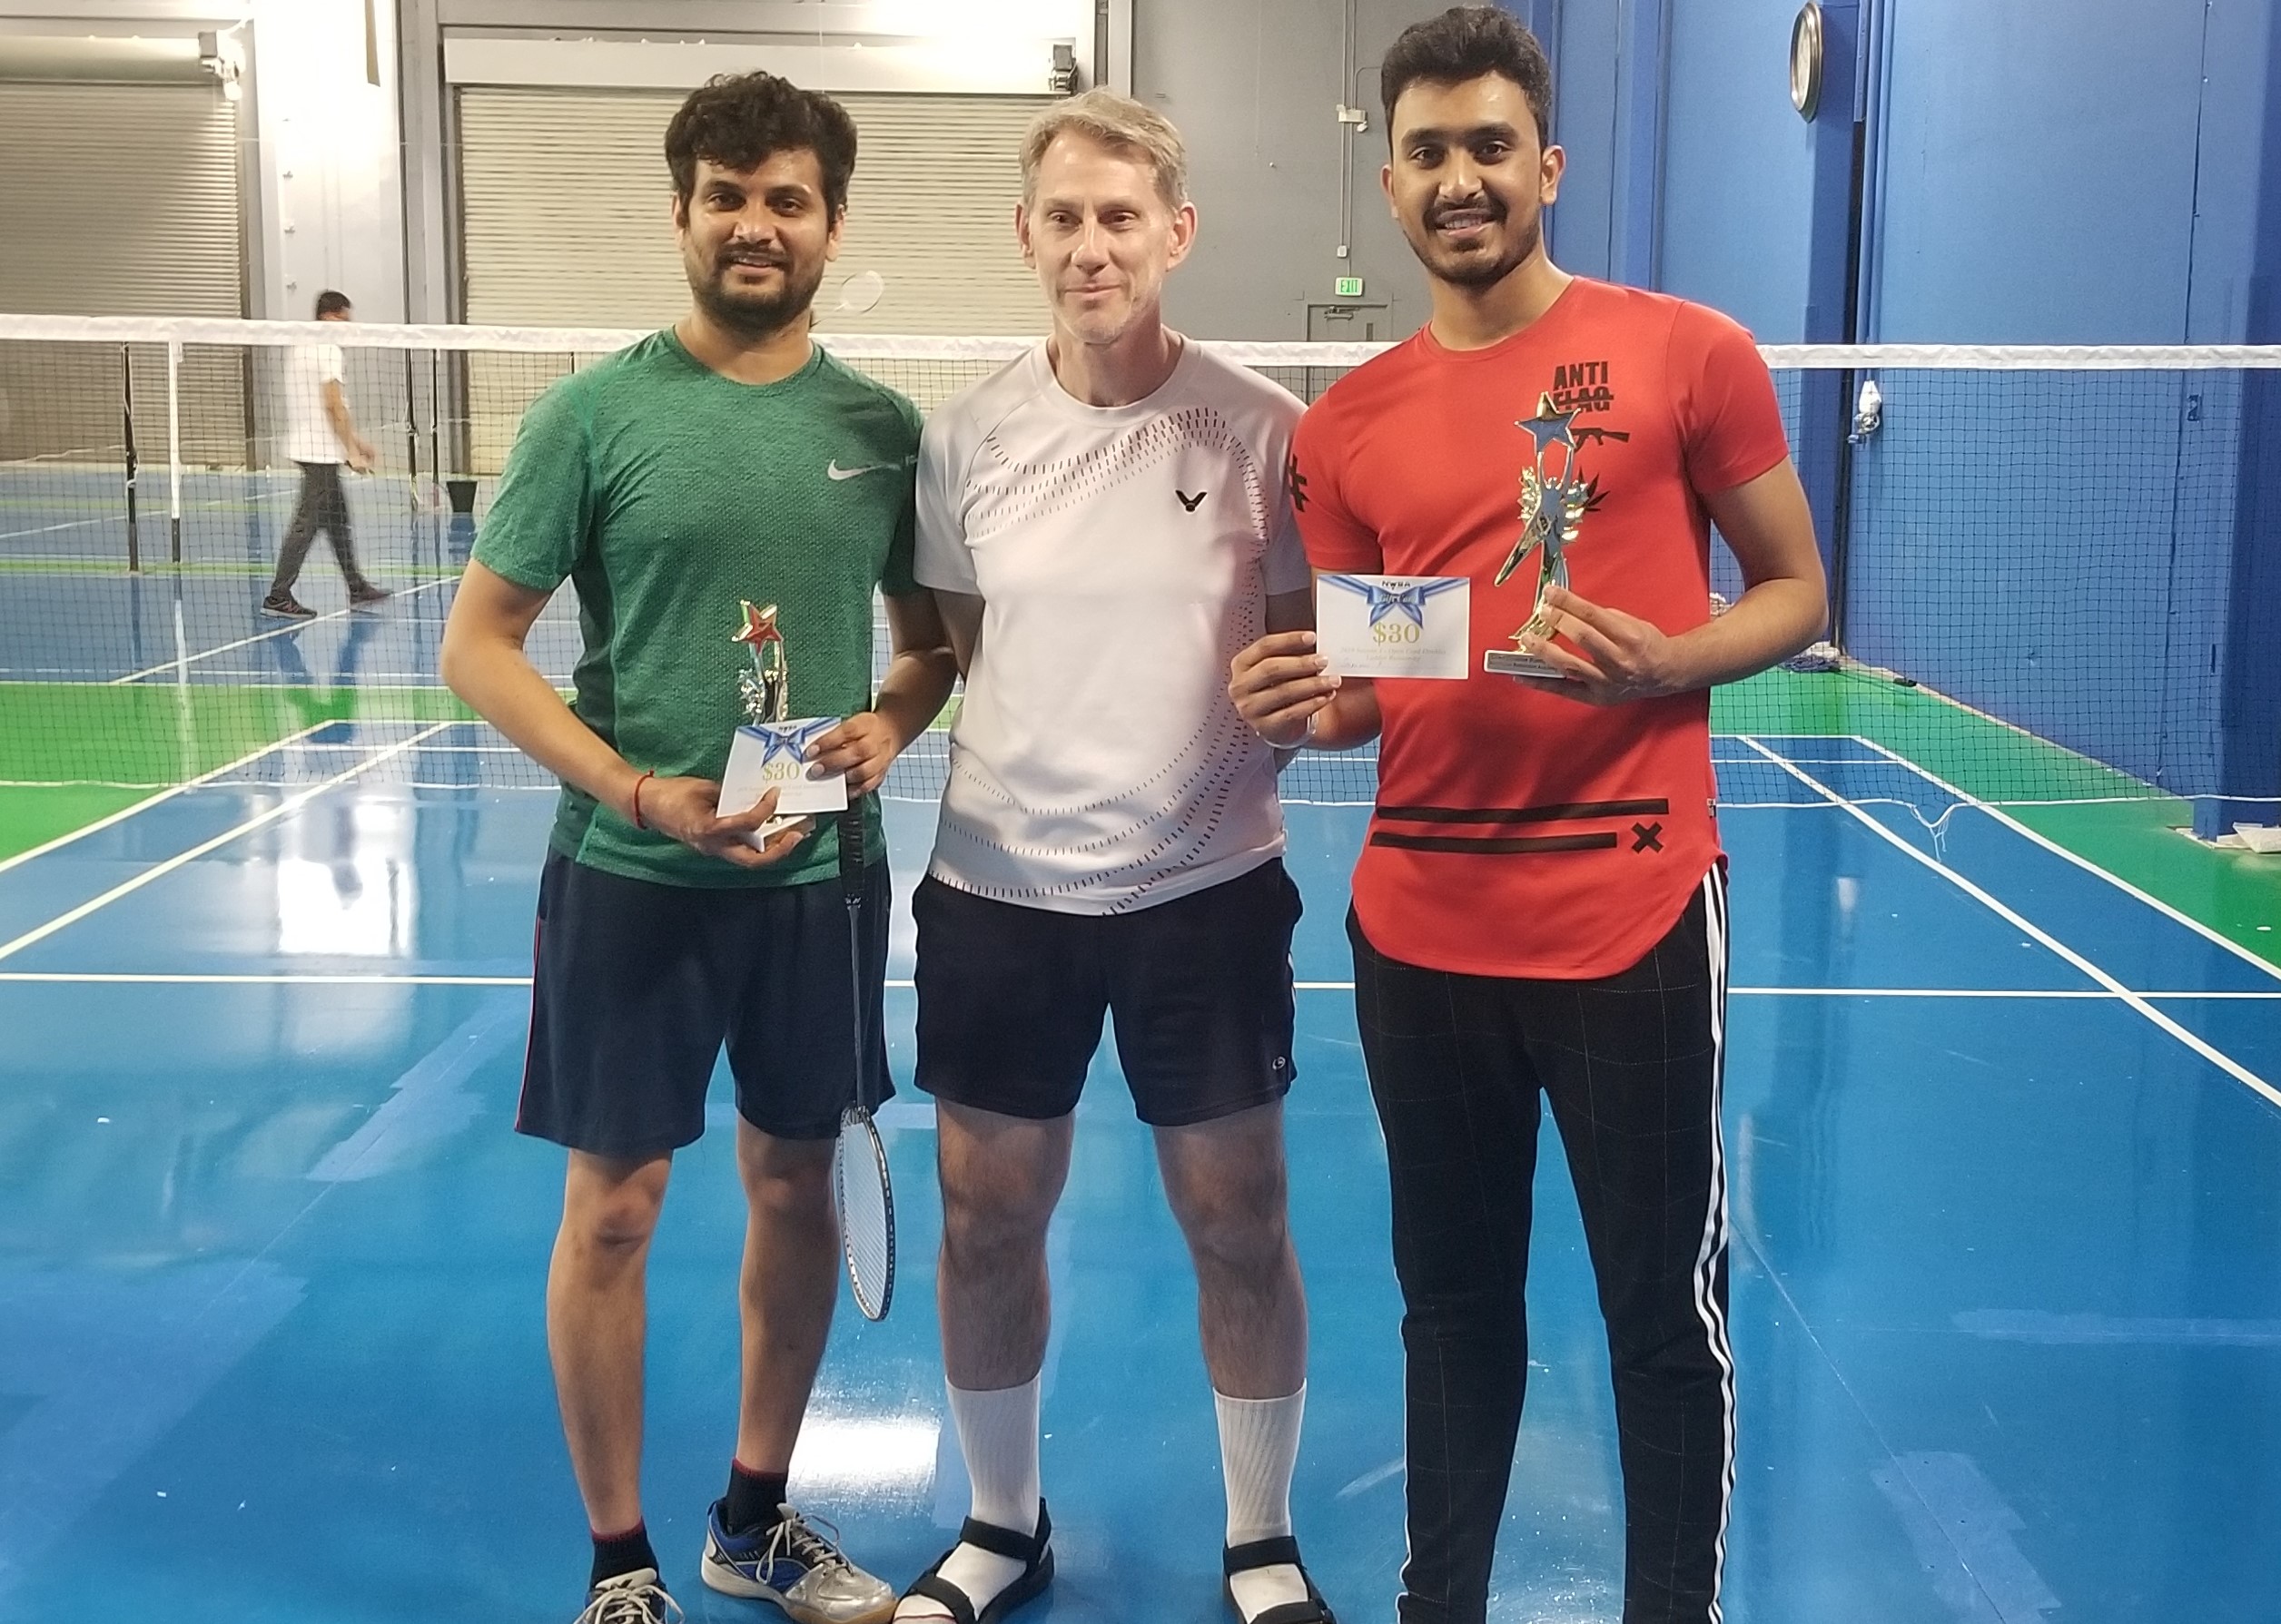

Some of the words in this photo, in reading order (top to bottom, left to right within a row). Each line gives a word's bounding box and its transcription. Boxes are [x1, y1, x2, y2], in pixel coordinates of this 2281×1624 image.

[1340, 279, 1358, 293] EXIT
[1553, 360, 1608, 391] ANTI
[1372, 622, 1420, 646] $30
[762, 762, 801, 783] $30
